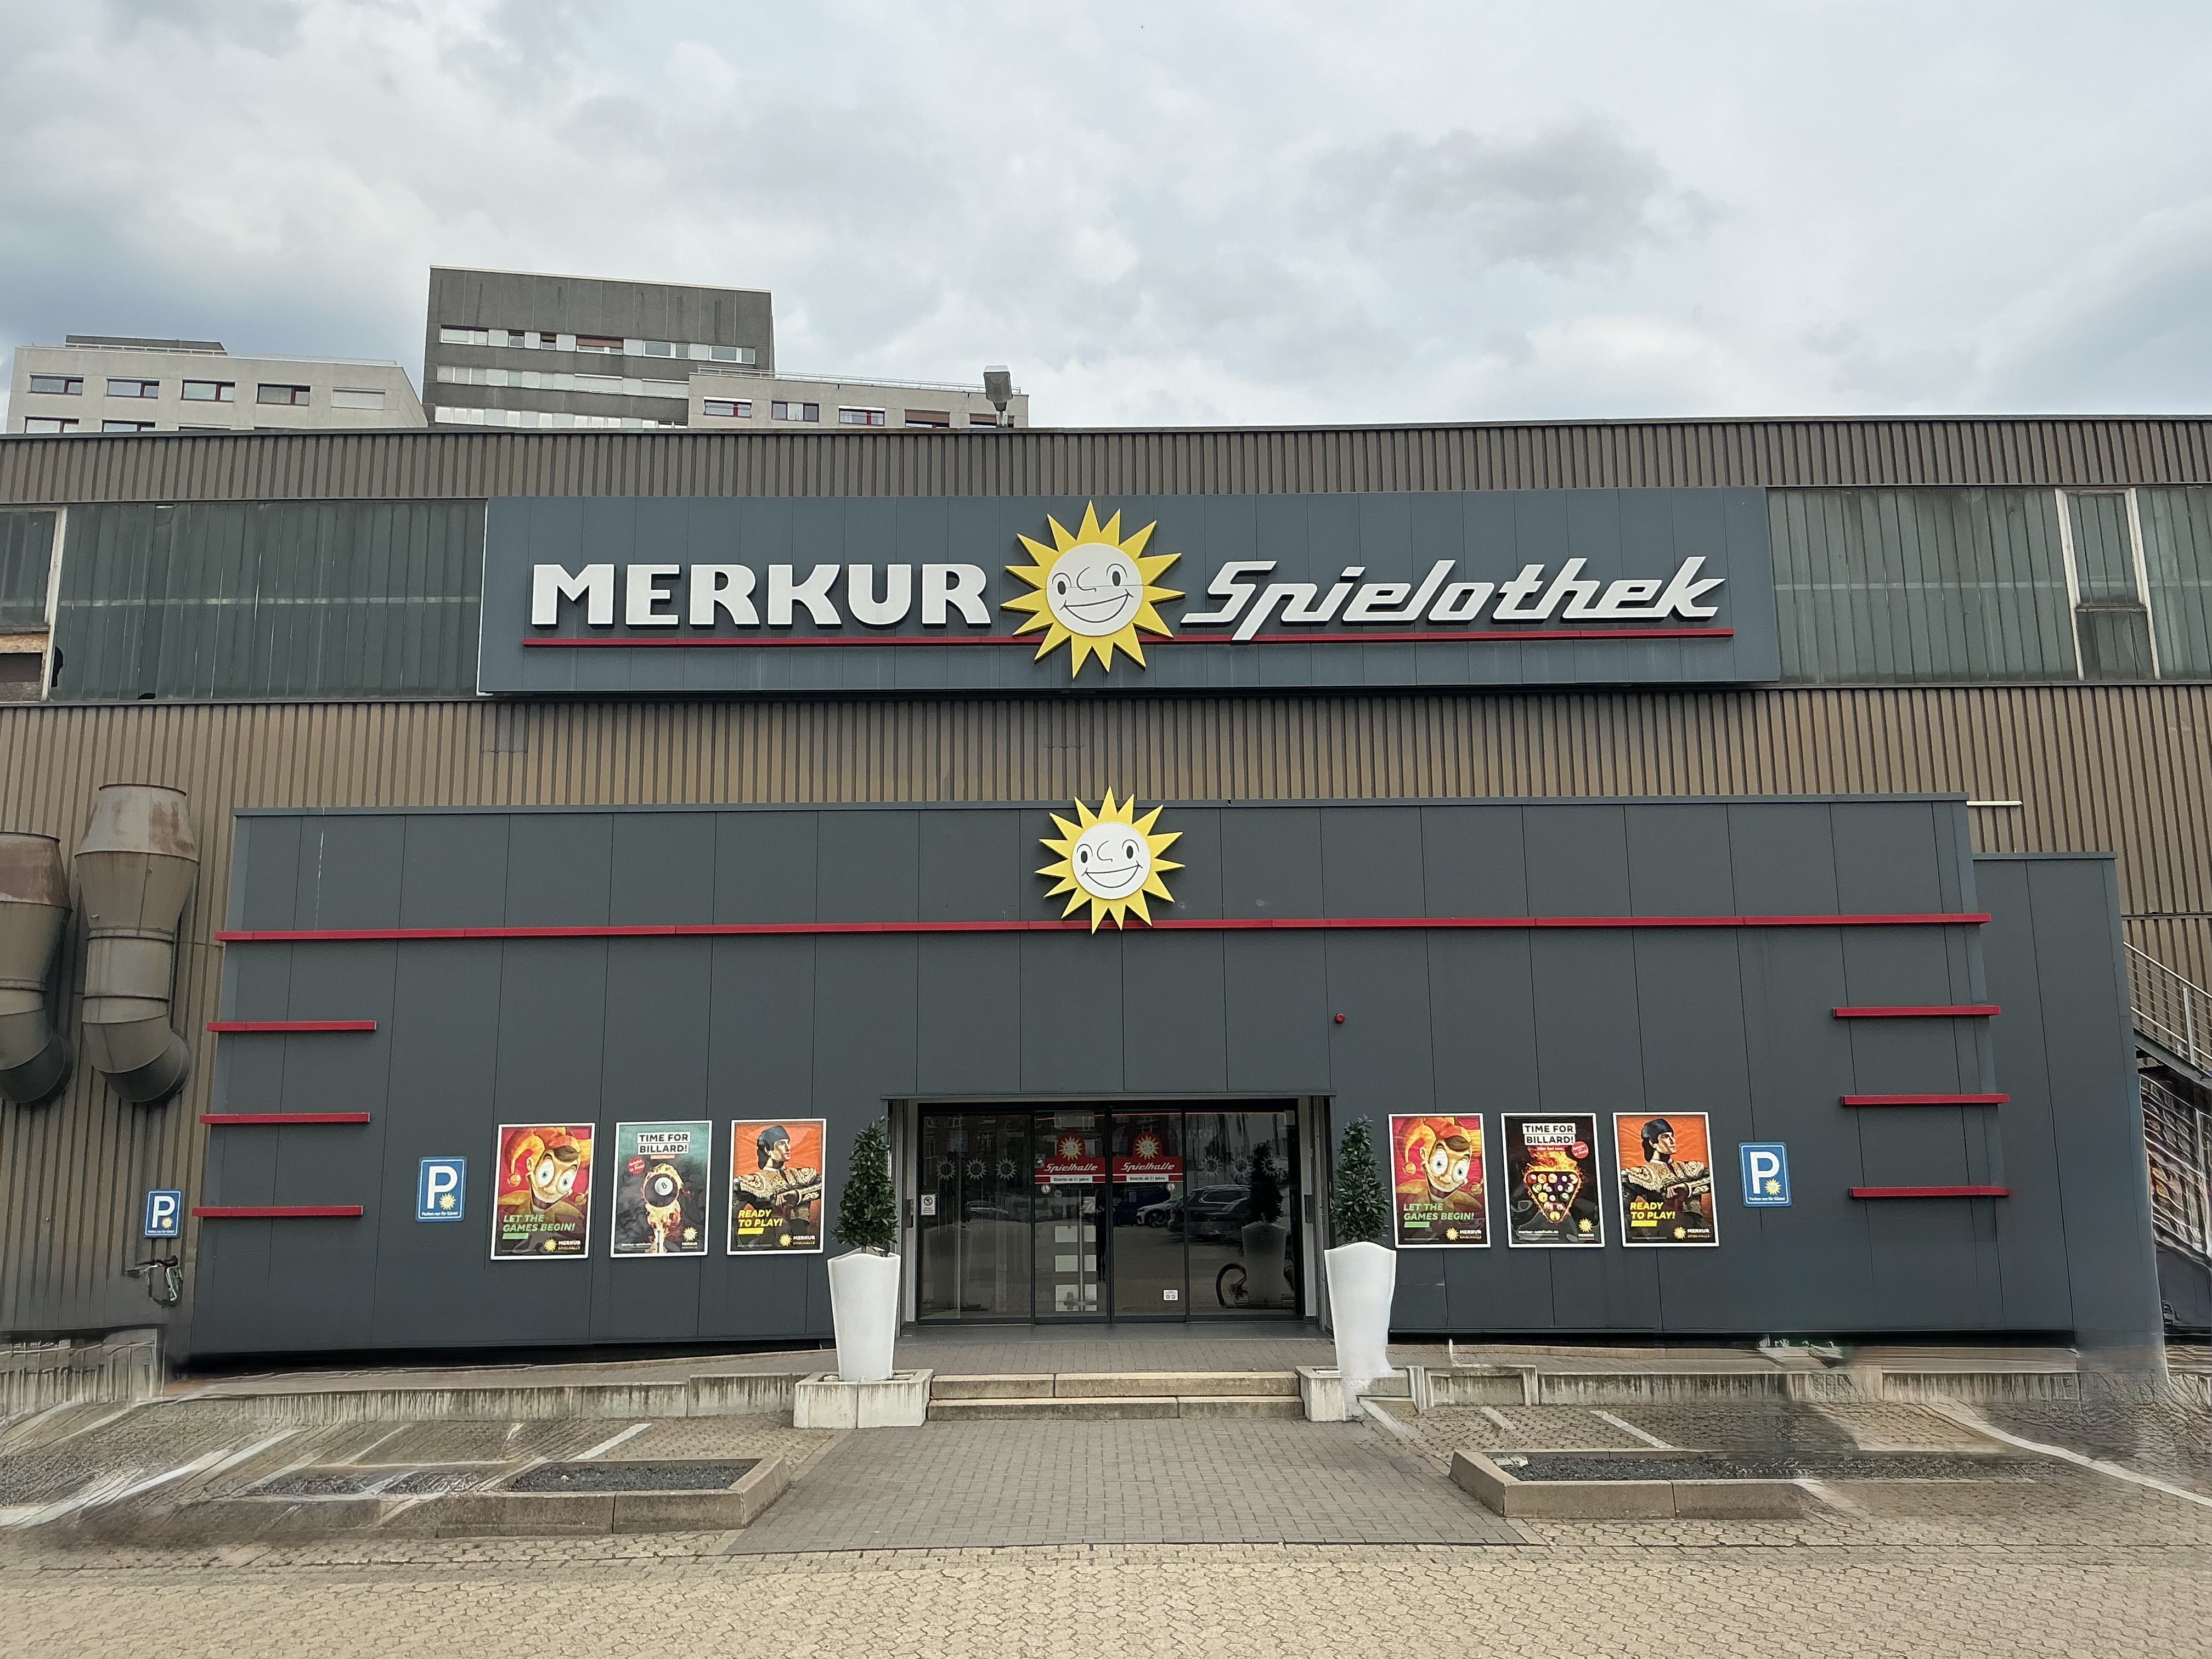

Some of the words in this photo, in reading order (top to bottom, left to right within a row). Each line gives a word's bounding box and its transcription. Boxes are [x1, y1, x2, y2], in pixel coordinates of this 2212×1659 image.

[532, 563, 991, 627] MERKUR
[1180, 556, 1726, 642] Spielothek
[1524, 1125, 1550, 1133] TIME
[1553, 1125, 1574, 1133] FOR
[1526, 1136, 1574, 1144] BILLARD!
[640, 1144, 687, 1153] BILLARD!
[1043, 1163, 1098, 1173] Spielhalle
[1120, 1162, 1175, 1172] Spielhalle
[1750, 1152, 1780, 1194] P
[427, 1166, 458, 1209] P
[1403, 1203, 1421, 1211] LET
[1424, 1203, 1444, 1211] THE
[1630, 1202, 1664, 1210] READY
[152, 1196, 175, 1228] P
[738, 1209, 772, 1218] READY
[1403, 1212, 1438, 1221] GAMES
[1440, 1212, 1475, 1220] BEGIN!
[1647, 1211, 1676, 1220] PLAY!
[503, 1215, 522, 1223] LET
[524, 1214, 545, 1222] THE
[738, 1219, 752, 1227] TO
[754, 1218, 783, 1227] PLAY!
[503, 1224, 539, 1232] GAMES
[540, 1223, 576, 1232] BEGIN!
